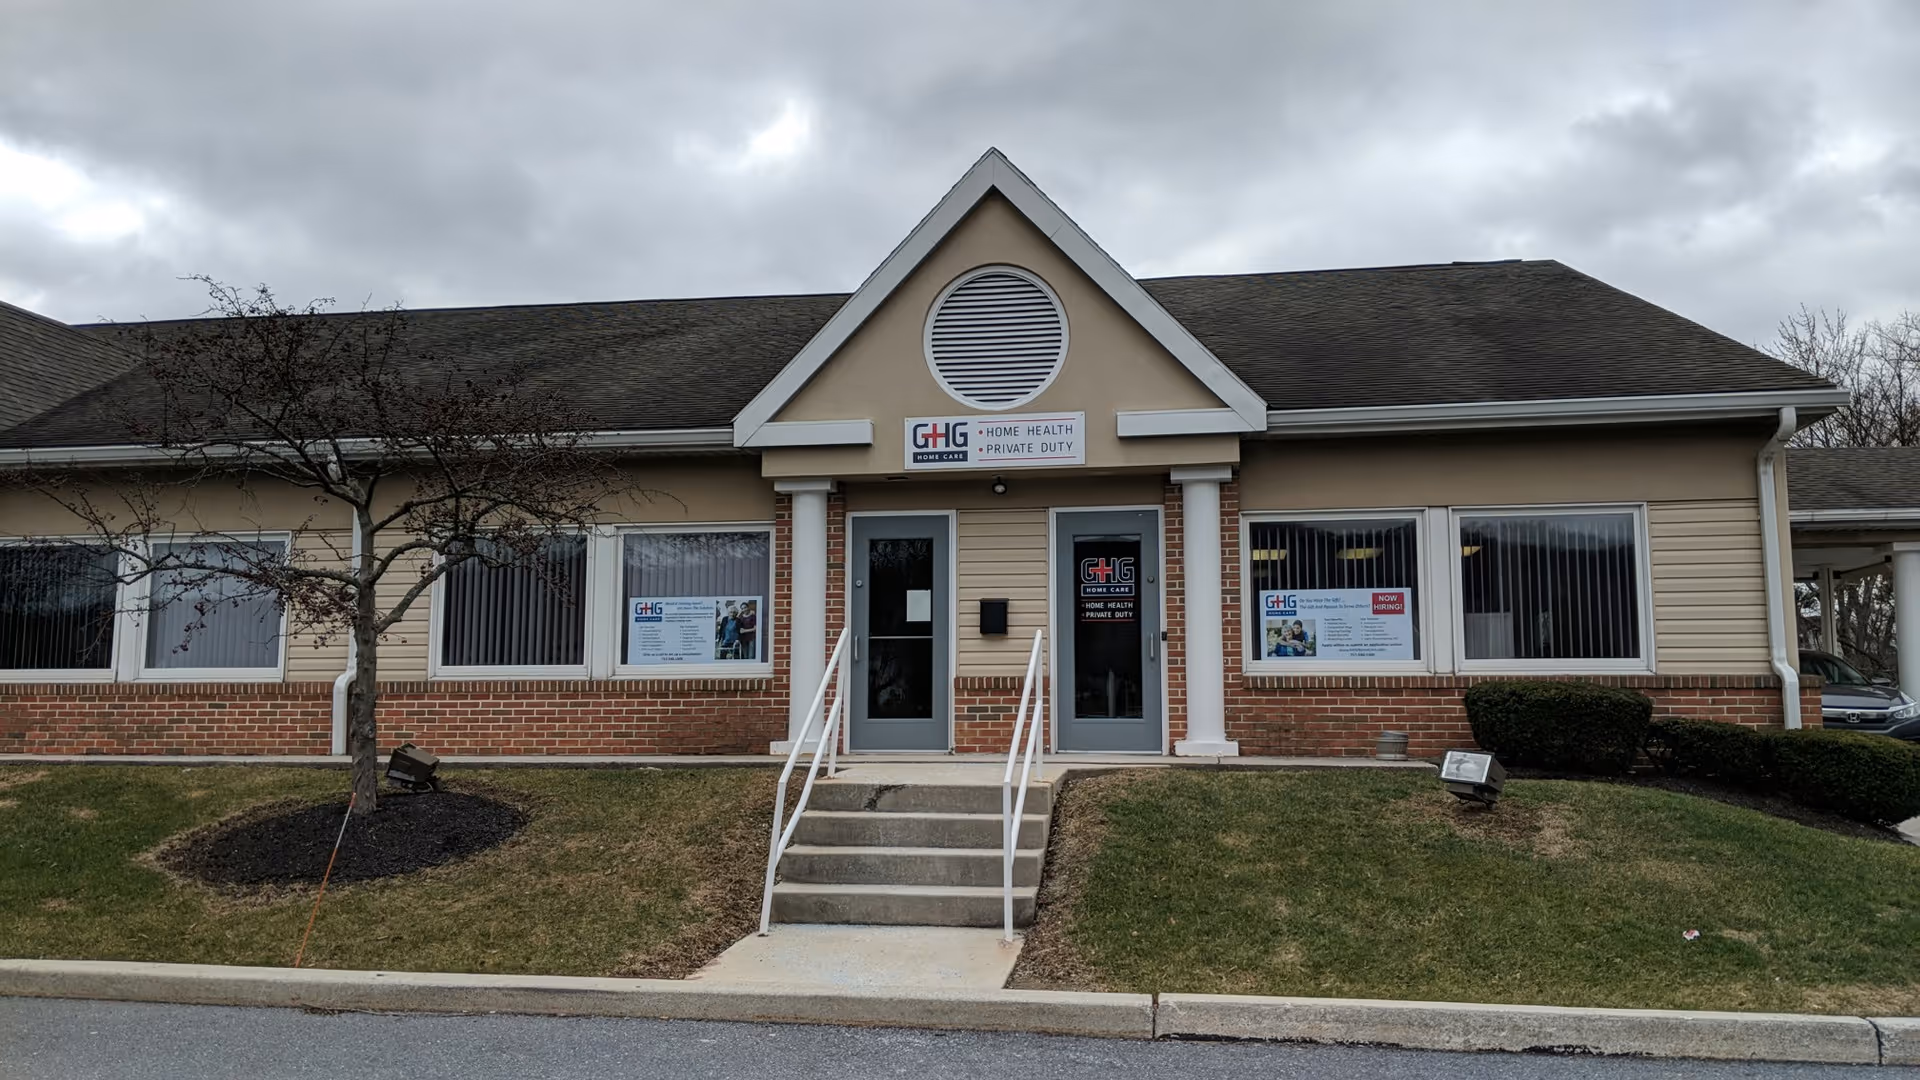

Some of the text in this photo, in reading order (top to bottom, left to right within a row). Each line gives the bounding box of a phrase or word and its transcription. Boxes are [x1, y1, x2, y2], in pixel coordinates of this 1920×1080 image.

[986, 424, 1073, 438] HOME HEALTH
[986, 441, 1073, 454] PRIVATE DUTY
[917, 453, 939, 461] HOME
[1373, 603, 1403, 611] HIRING!
